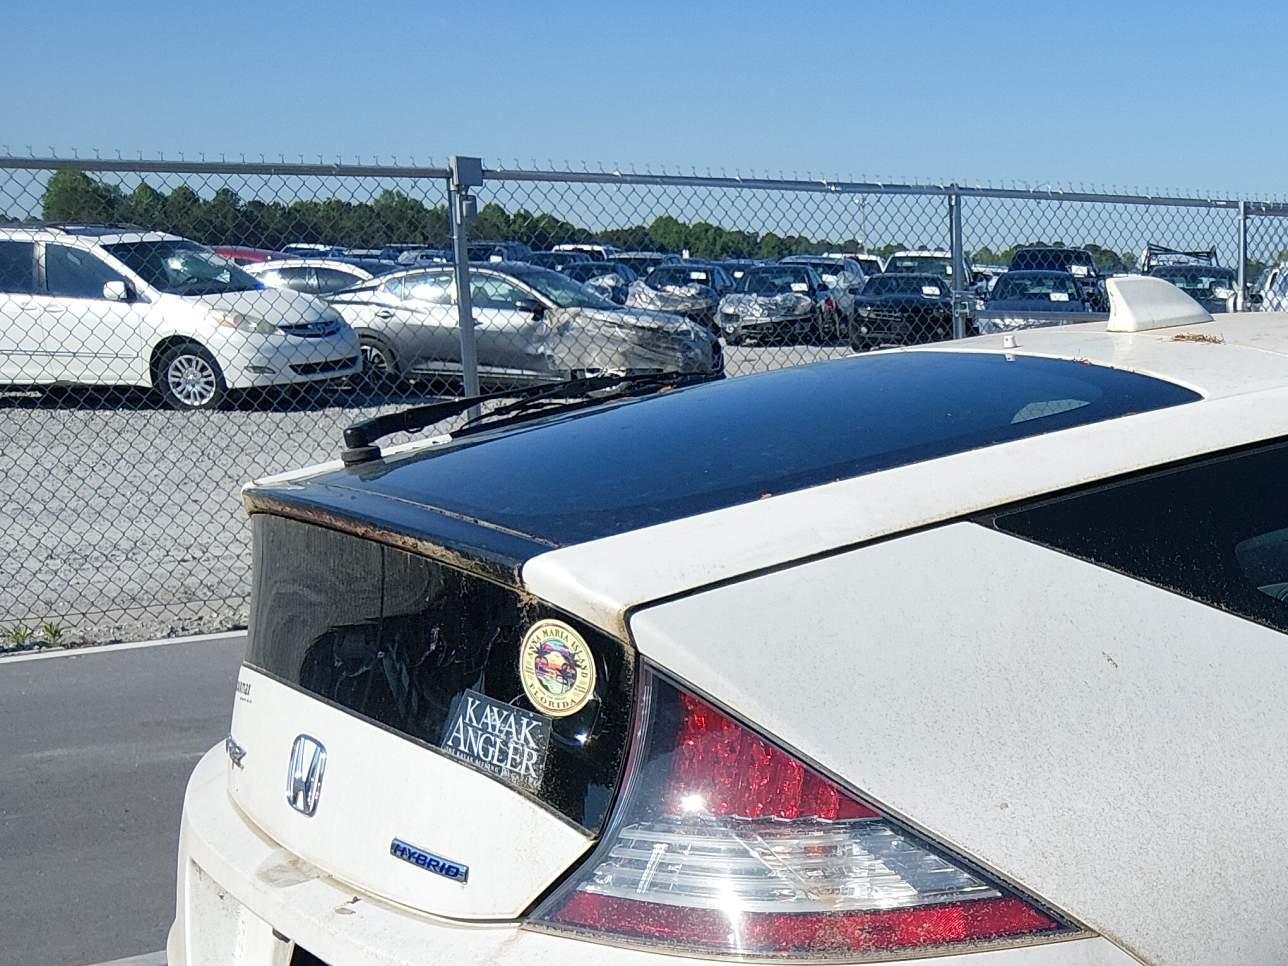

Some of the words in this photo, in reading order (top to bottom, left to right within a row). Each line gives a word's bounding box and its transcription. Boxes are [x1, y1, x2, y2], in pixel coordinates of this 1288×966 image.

[528, 635, 541, 656] ANNA
[542, 628, 570, 643] MARIA
[571, 641, 589, 678] ISLAND
[528, 682, 577, 709] FLORIDA
[446, 714, 538, 779] ANGLER
[463, 697, 542, 749] KAYAK
[393, 842, 461, 878] HYBRID
